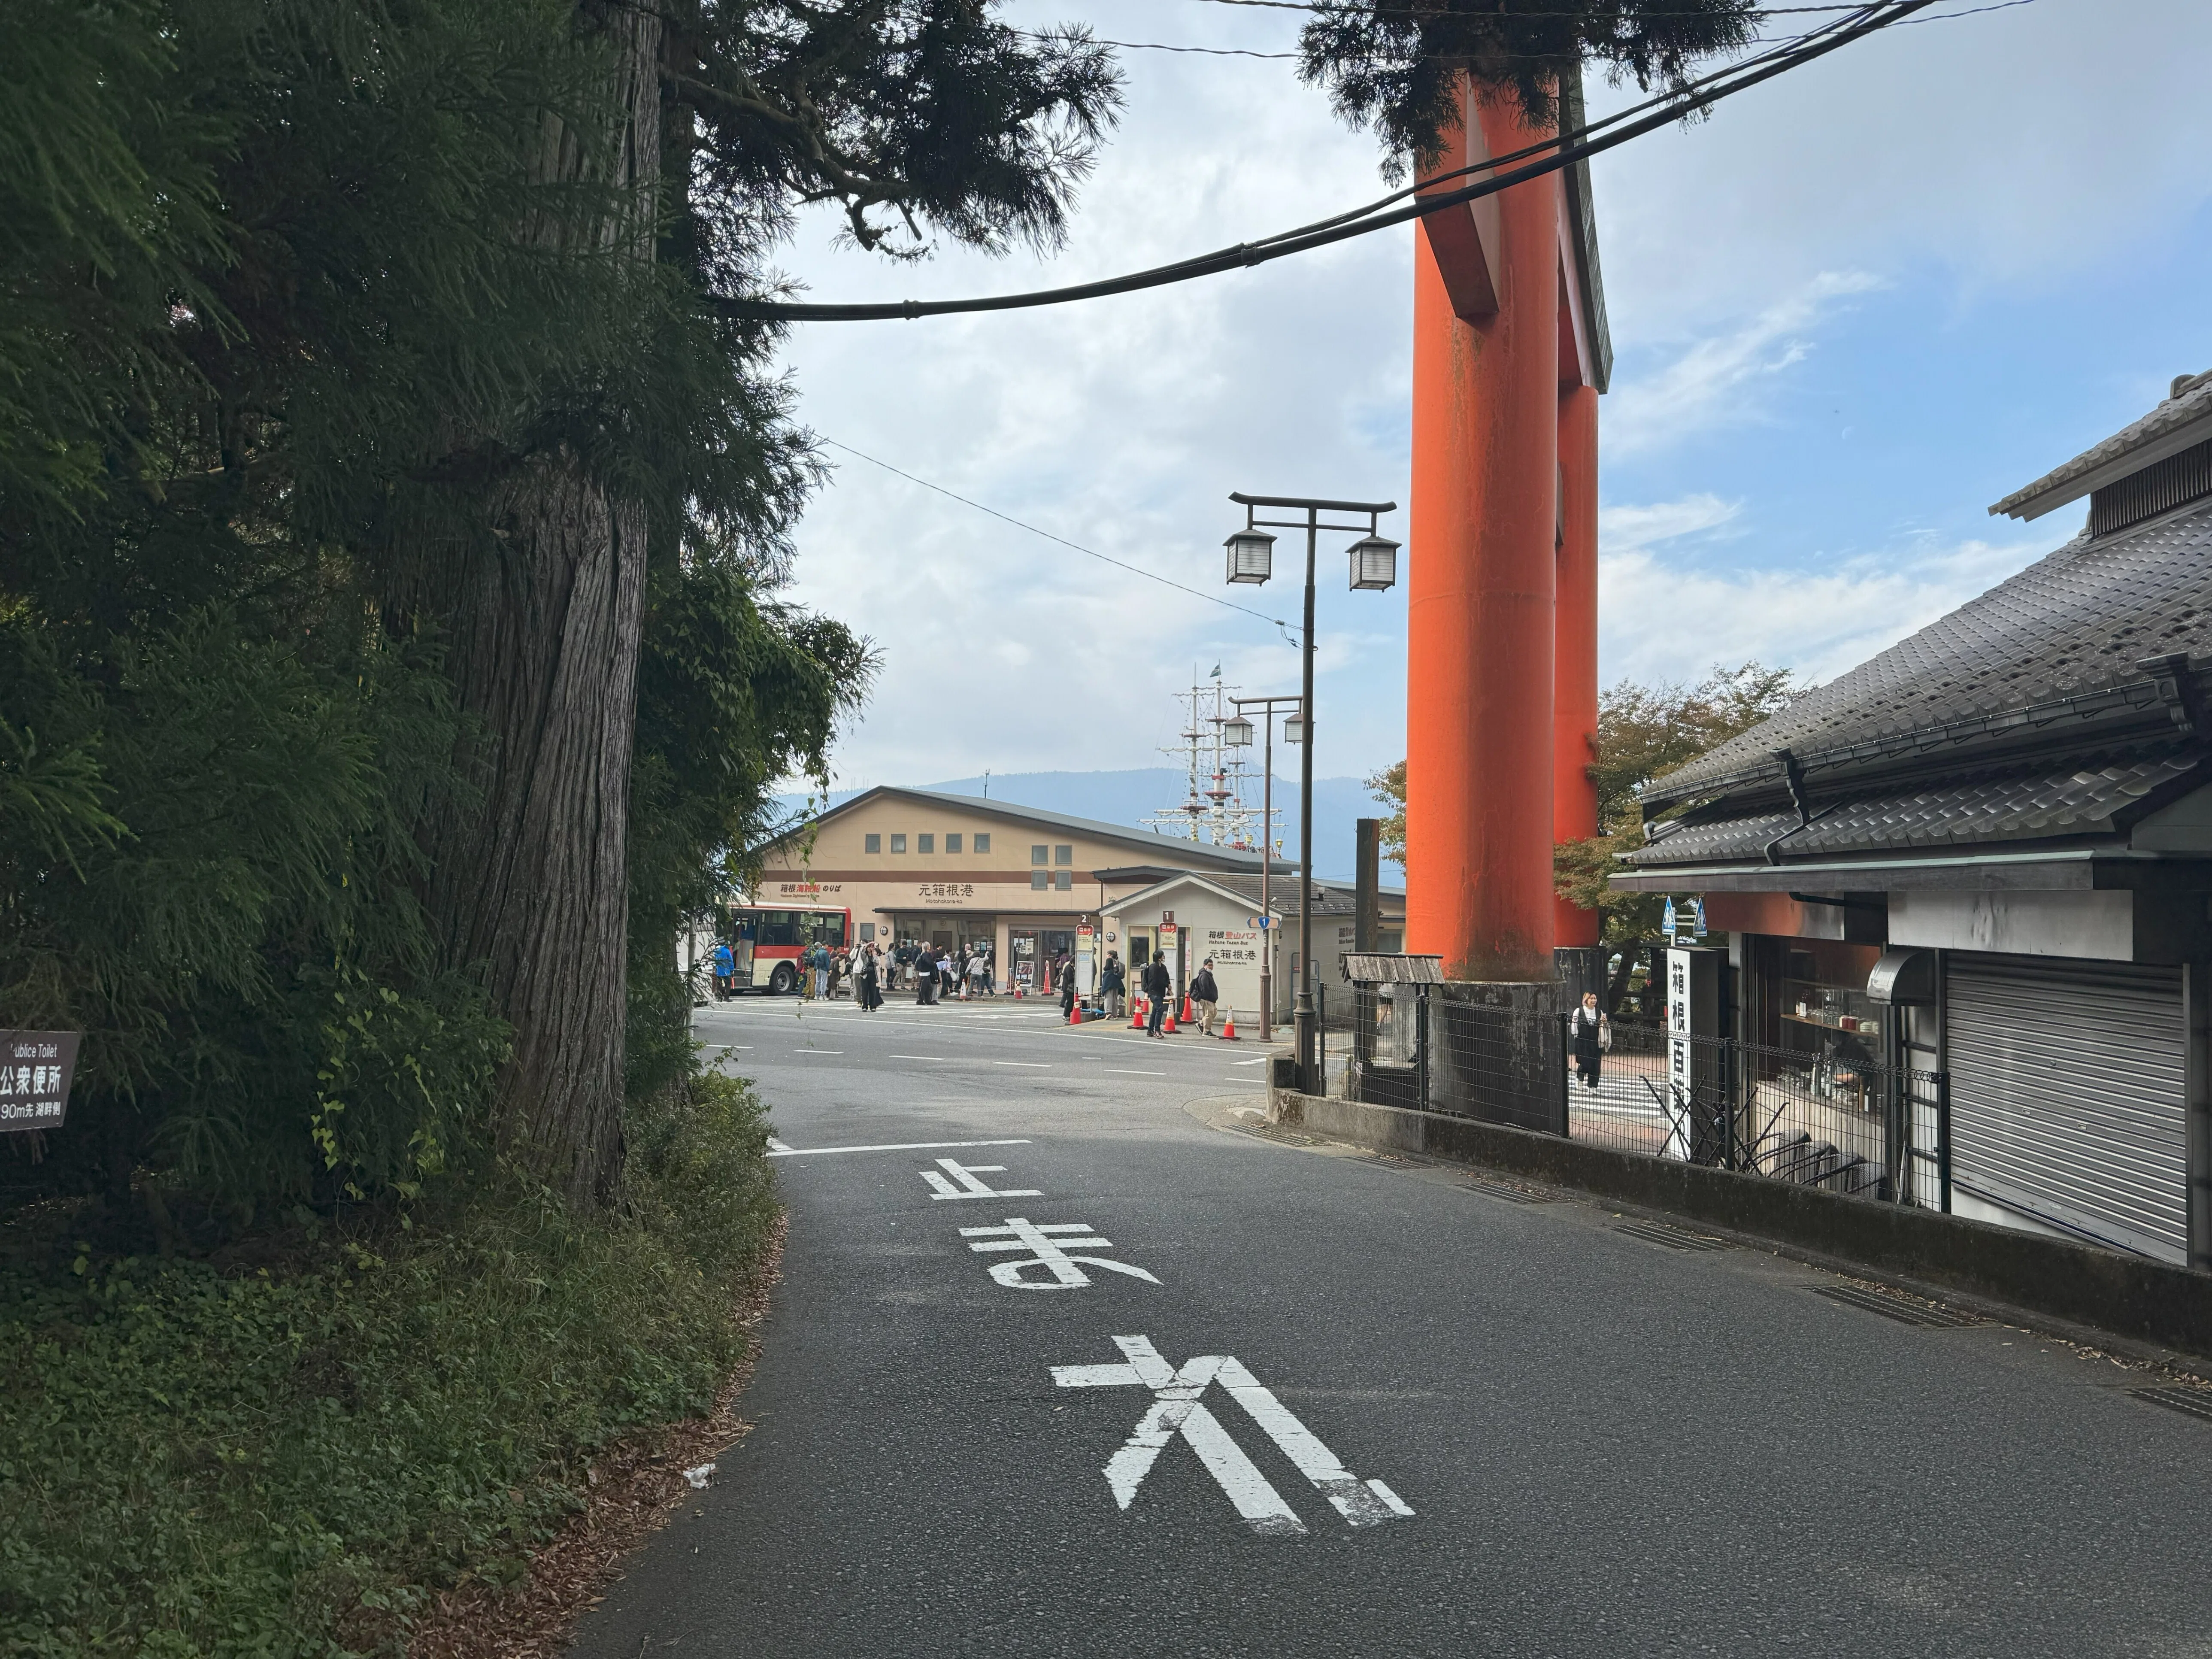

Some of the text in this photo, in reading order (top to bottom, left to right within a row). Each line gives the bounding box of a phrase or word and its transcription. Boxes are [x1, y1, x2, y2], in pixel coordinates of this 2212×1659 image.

[919, 883, 973, 897] 元箱根港
[1165, 912, 1169, 920] 1
[1262, 918, 1265, 926] 1
[1209, 931, 1257, 940] 箱根登山バス
[1209, 949, 1256, 960] 元箱根港
[38, 1043, 57, 1058] Toilet
[0, 1065, 61, 1095] 公衆便所
[0, 1101, 61, 1119] 90m先 湖畔側
[918, 1159, 1416, 1535] 止まれ
